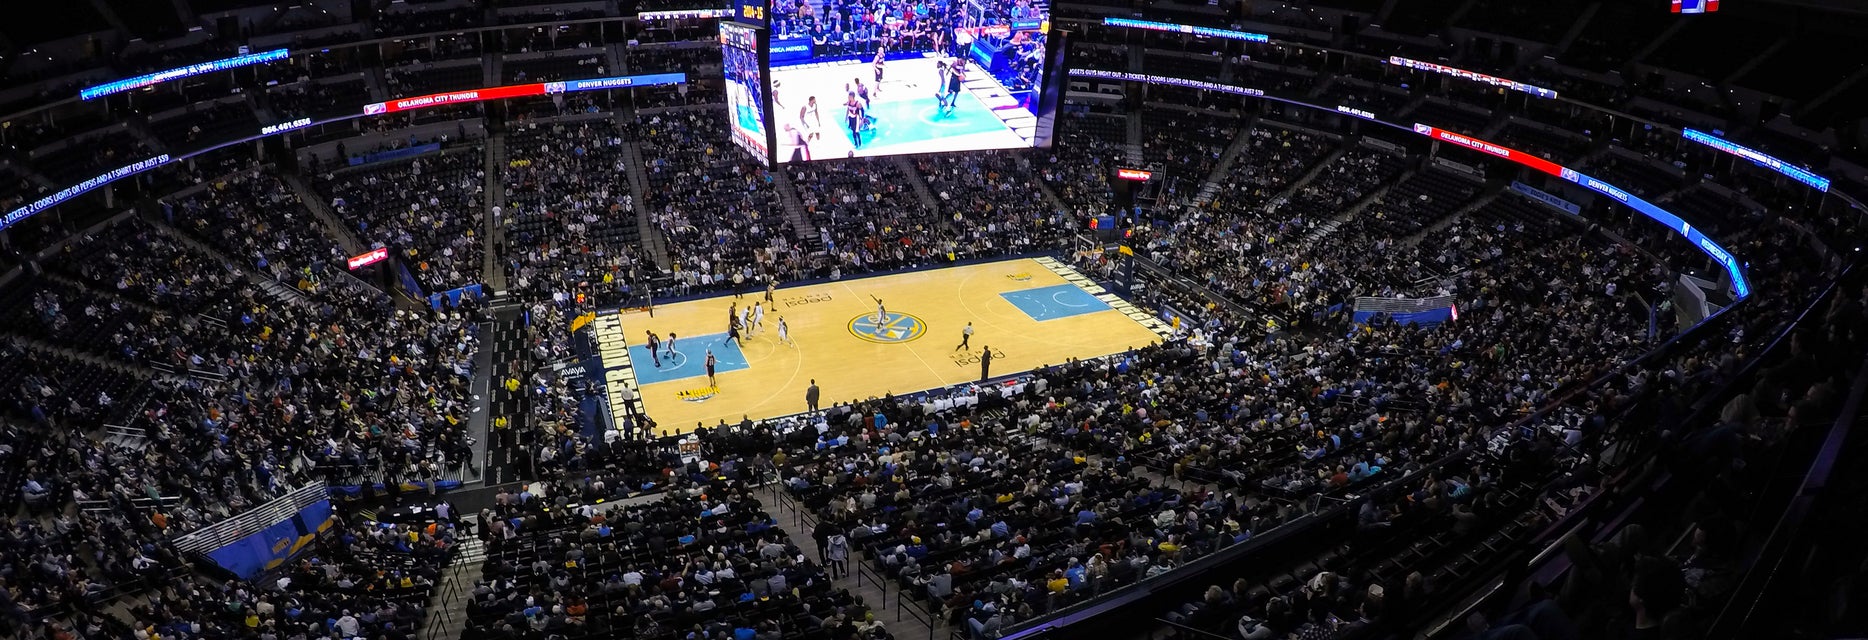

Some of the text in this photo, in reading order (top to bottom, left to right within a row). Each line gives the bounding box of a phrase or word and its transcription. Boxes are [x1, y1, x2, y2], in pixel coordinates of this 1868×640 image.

[577, 78, 632, 89] DENVER NUGGETS
[397, 97, 434, 109] OKLAHOMA
[434, 94, 448, 104] CITY
[448, 91, 479, 102] THUNDER
[1440, 132, 1509, 157] OKLAHOMA CITY THUNDER
[34, 196, 54, 210] COORS
[54, 187, 73, 203] LIGHTS
[72, 184, 81, 195] OR
[80, 178, 97, 192] PEPSIS
[96, 173, 109, 187] AND
[111, 165, 132, 181] T-SHIRT
[132, 160, 145, 172] FOR
[144, 156, 158, 169] JUST
[1588, 179, 1628, 202] DENVER NUGGETS
[1031, 255, 1106, 295] DENVER
[785, 295, 833, 308] pepsi
[954, 350, 1006, 368] ppsi
[561, 366, 587, 377] AVAYA
